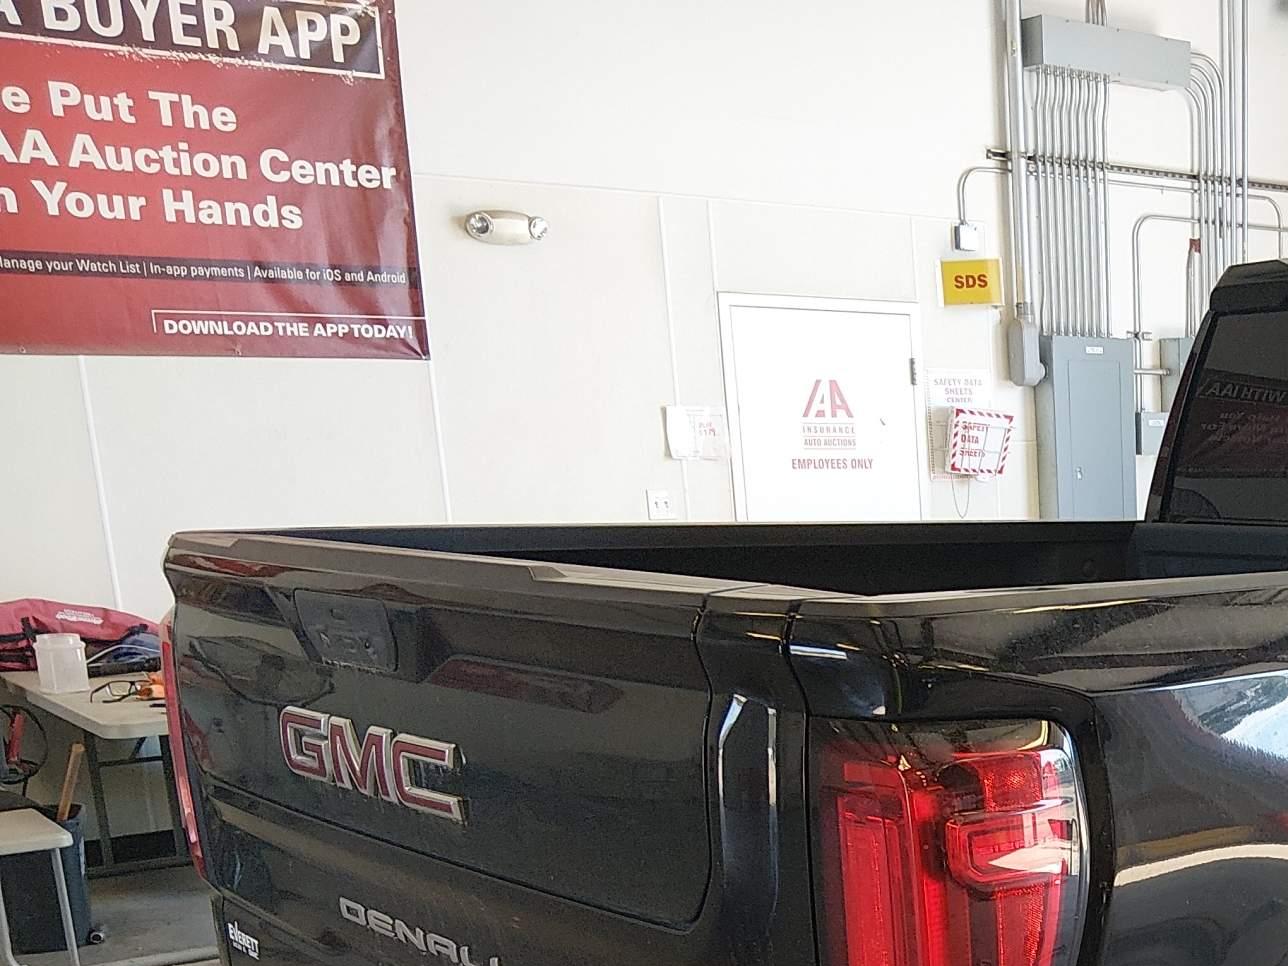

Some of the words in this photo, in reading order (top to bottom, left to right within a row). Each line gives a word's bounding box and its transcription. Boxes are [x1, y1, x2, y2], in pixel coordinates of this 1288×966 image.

[42, 0, 240, 51] BUYER
[258, 6, 361, 63] APP
[48, 80, 136, 124] Put
[148, 91, 238, 132] The
[68, 132, 248, 181] Auction
[259, 148, 397, 189] Center
[30, 179, 147, 220] Your
[162, 188, 303, 230] Hands
[0, 255, 43, 272] anage
[46, 261, 75, 273] your
[75, 258, 118, 274] Watch
[119, 261, 142, 274] List
[149, 262, 188, 278] In-app
[190, 265, 245, 280] payments
[253, 266, 304, 281] Available
[304, 268, 321, 281] for
[322, 268, 342, 282] iOS
[344, 270, 364, 283] and
[366, 271, 407, 285] Android
[954, 274, 988, 289] SDS
[163, 318, 273, 337] DOWNLOAD
[274, 321, 310, 337] THE
[313, 323, 350, 338] APP
[353, 324, 414, 339] TODAY!
[802, 425, 856, 434] INSURANCE
[804, 438, 822, 447] AUTO
[823, 438, 857, 447] AUCTIONS
[791, 458, 848, 470] EMPLOYEES
[850, 458, 874, 470] ONLY
[279, 705, 465, 826] GMC
[227, 920, 259, 953] EVERETT
